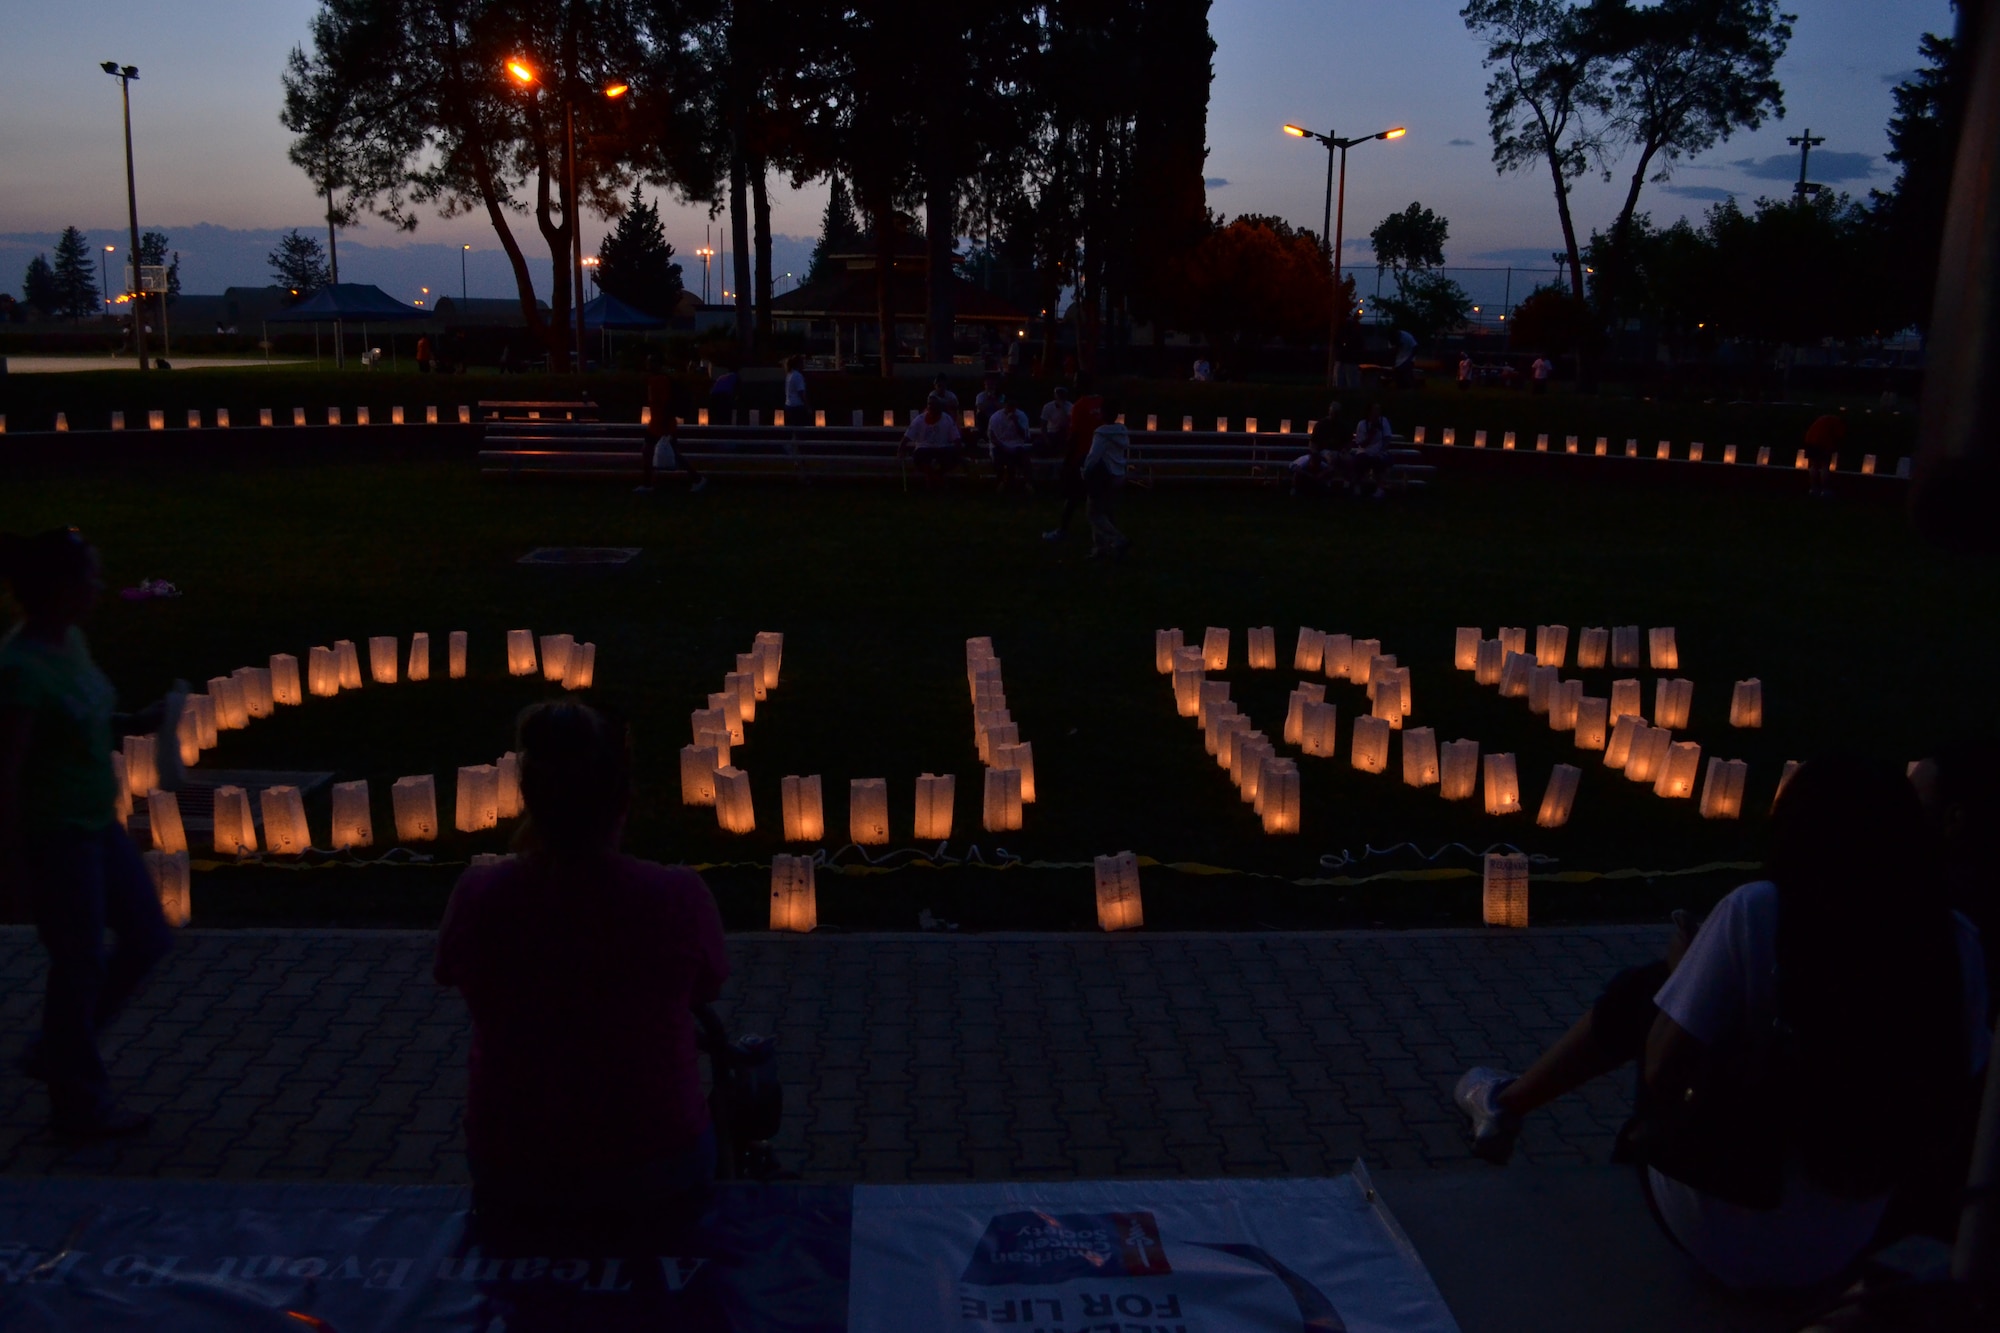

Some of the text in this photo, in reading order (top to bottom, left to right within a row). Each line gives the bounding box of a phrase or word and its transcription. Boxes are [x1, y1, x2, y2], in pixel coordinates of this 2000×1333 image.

[1016, 1225, 1108, 1242] Society
[1024, 1237, 1111, 1253] Cancer
[102, 1253, 187, 1288] To
[213, 1255, 417, 1291] Event
[990, 1247, 1112, 1267] American
[435, 1254, 633, 1293] Team
[656, 1255, 711, 1293] A
[961, 1294, 1183, 1323] FOR LIFE
